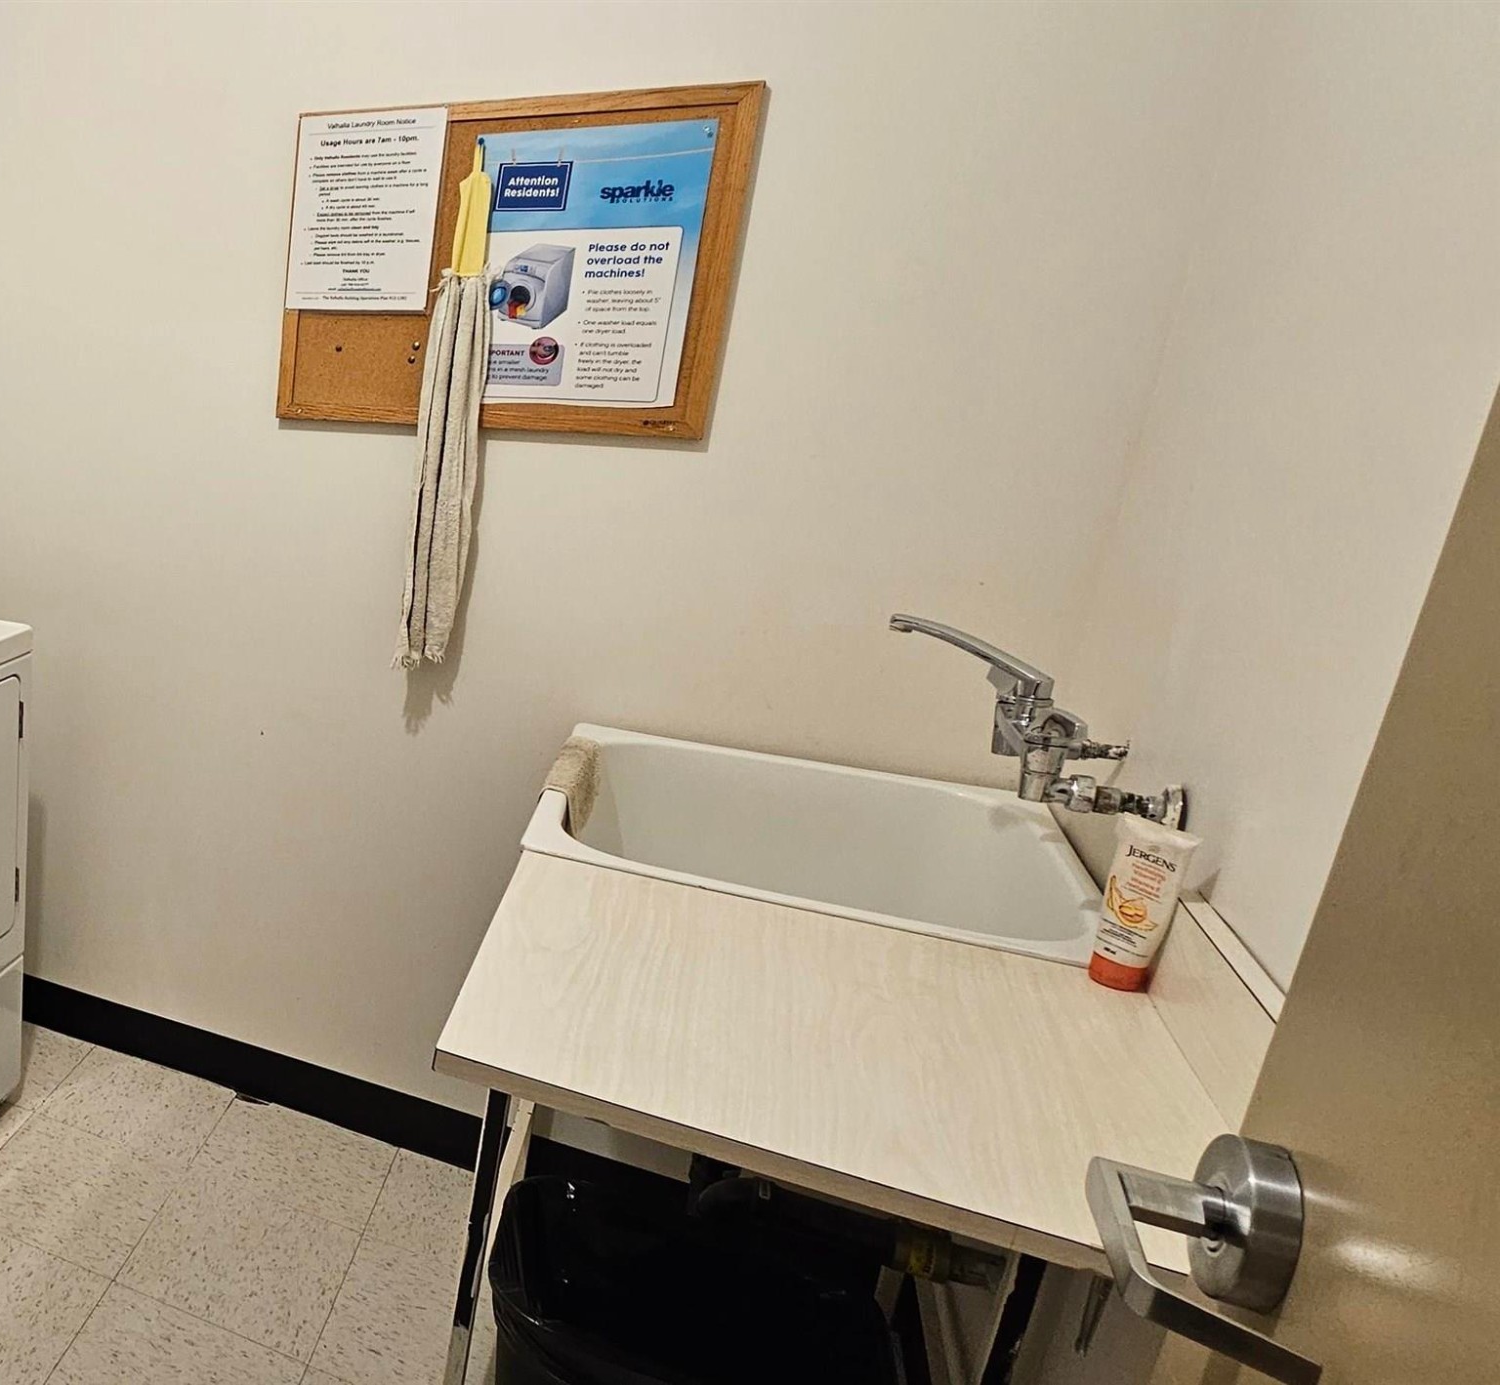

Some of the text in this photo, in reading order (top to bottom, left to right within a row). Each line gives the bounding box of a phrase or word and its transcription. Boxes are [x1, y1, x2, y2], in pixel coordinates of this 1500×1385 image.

[508, 174, 558, 186] Attention
[504, 187, 560, 198] Residents!
[588, 242, 670, 252] Please do not
[586, 255, 663, 265] overload the
[584, 268, 645, 278] machines!
[1125, 845, 1177, 872] JERGENS
